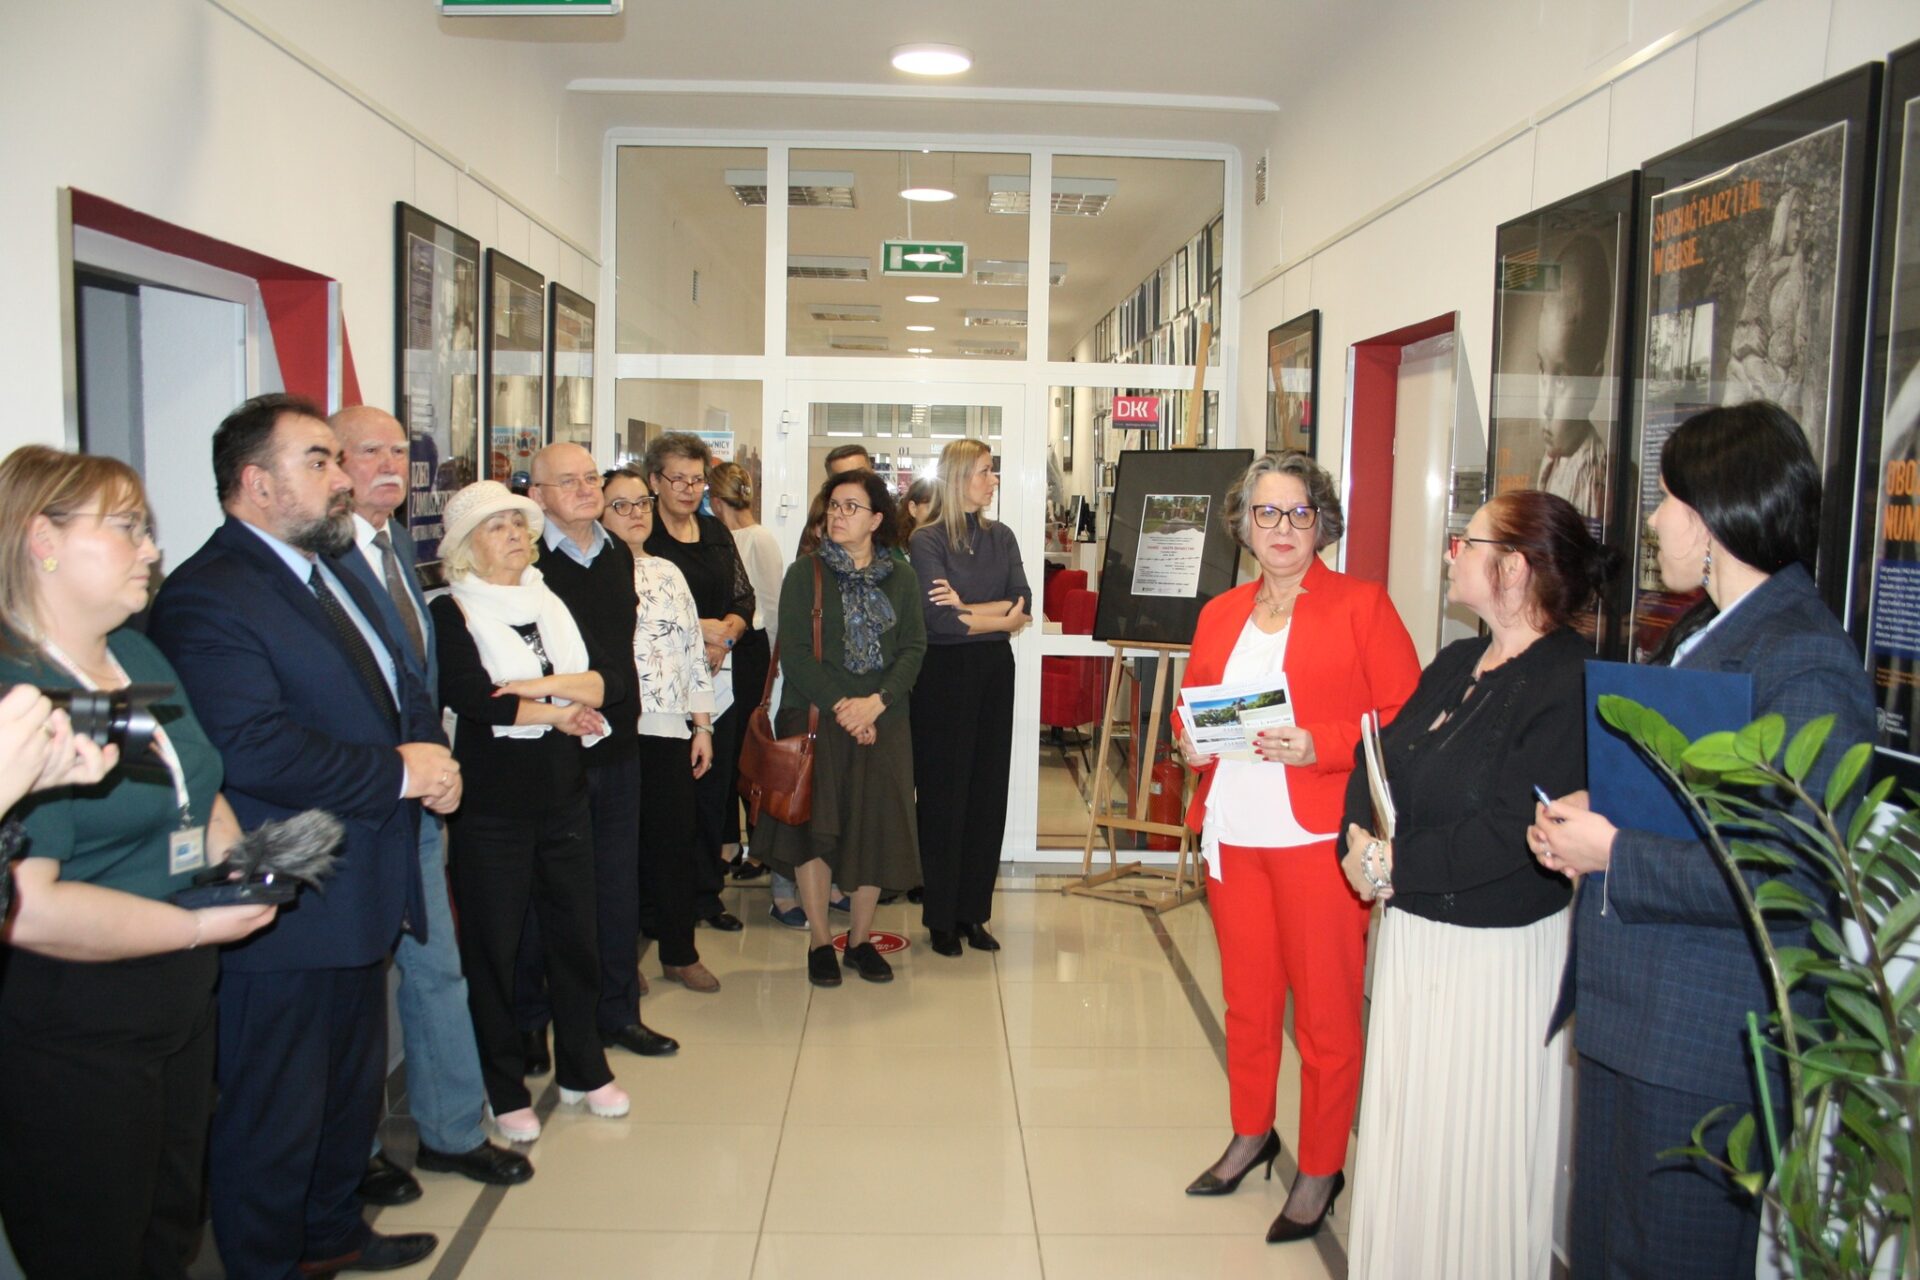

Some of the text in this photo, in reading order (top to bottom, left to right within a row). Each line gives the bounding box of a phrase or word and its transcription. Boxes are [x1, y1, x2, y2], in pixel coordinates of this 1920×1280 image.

[1698, 188, 1731, 228] PŁACZ
[1733, 186, 1739, 217] I
[1653, 247, 1664, 276] W
[1886, 459, 1920, 496] OBO
